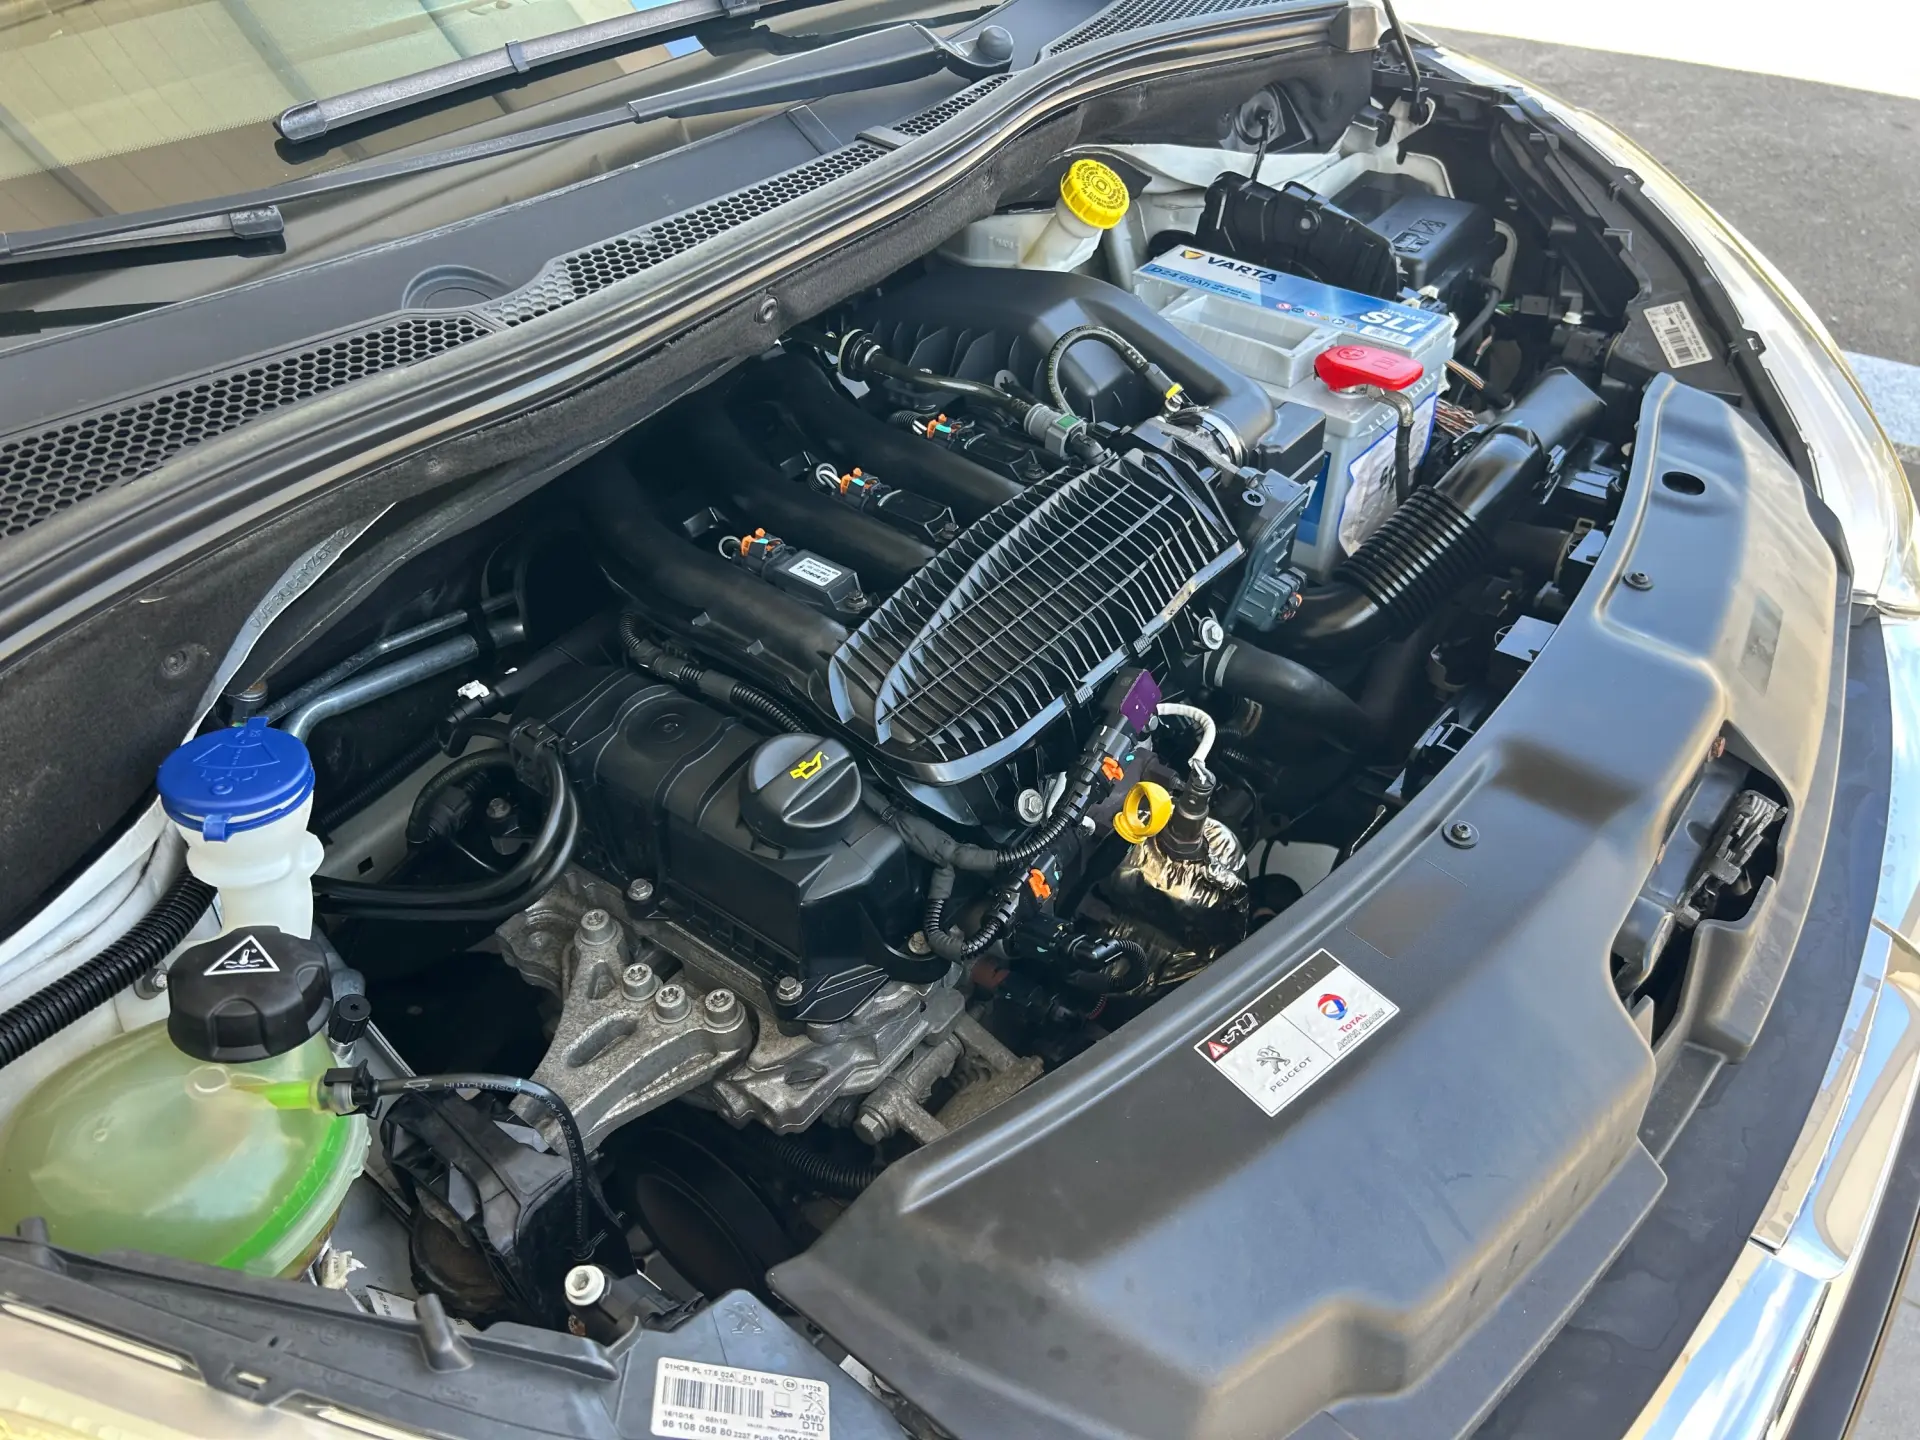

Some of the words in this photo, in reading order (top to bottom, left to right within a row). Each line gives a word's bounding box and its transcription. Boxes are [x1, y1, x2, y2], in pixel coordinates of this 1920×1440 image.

[1150, 267, 1178, 278] D24
[1180, 275, 1210, 288] 60Ah
[1207, 257, 1277, 282] VARTA
[1360, 311, 1426, 334] SLI
[1269, 1056, 1311, 1092] PEUGEOT
[664, 1363, 690, 1372] 01HCR
[692, 1366, 702, 1375] PL
[799, 1413, 824, 1423] A9MV
[802, 1420, 825, 1432] DTD
[662, 1419, 674, 1428] 98
[678, 1421, 696, 1432] 108
[698, 1424, 716, 1434] 058
[719, 1427, 732, 1437] 80
